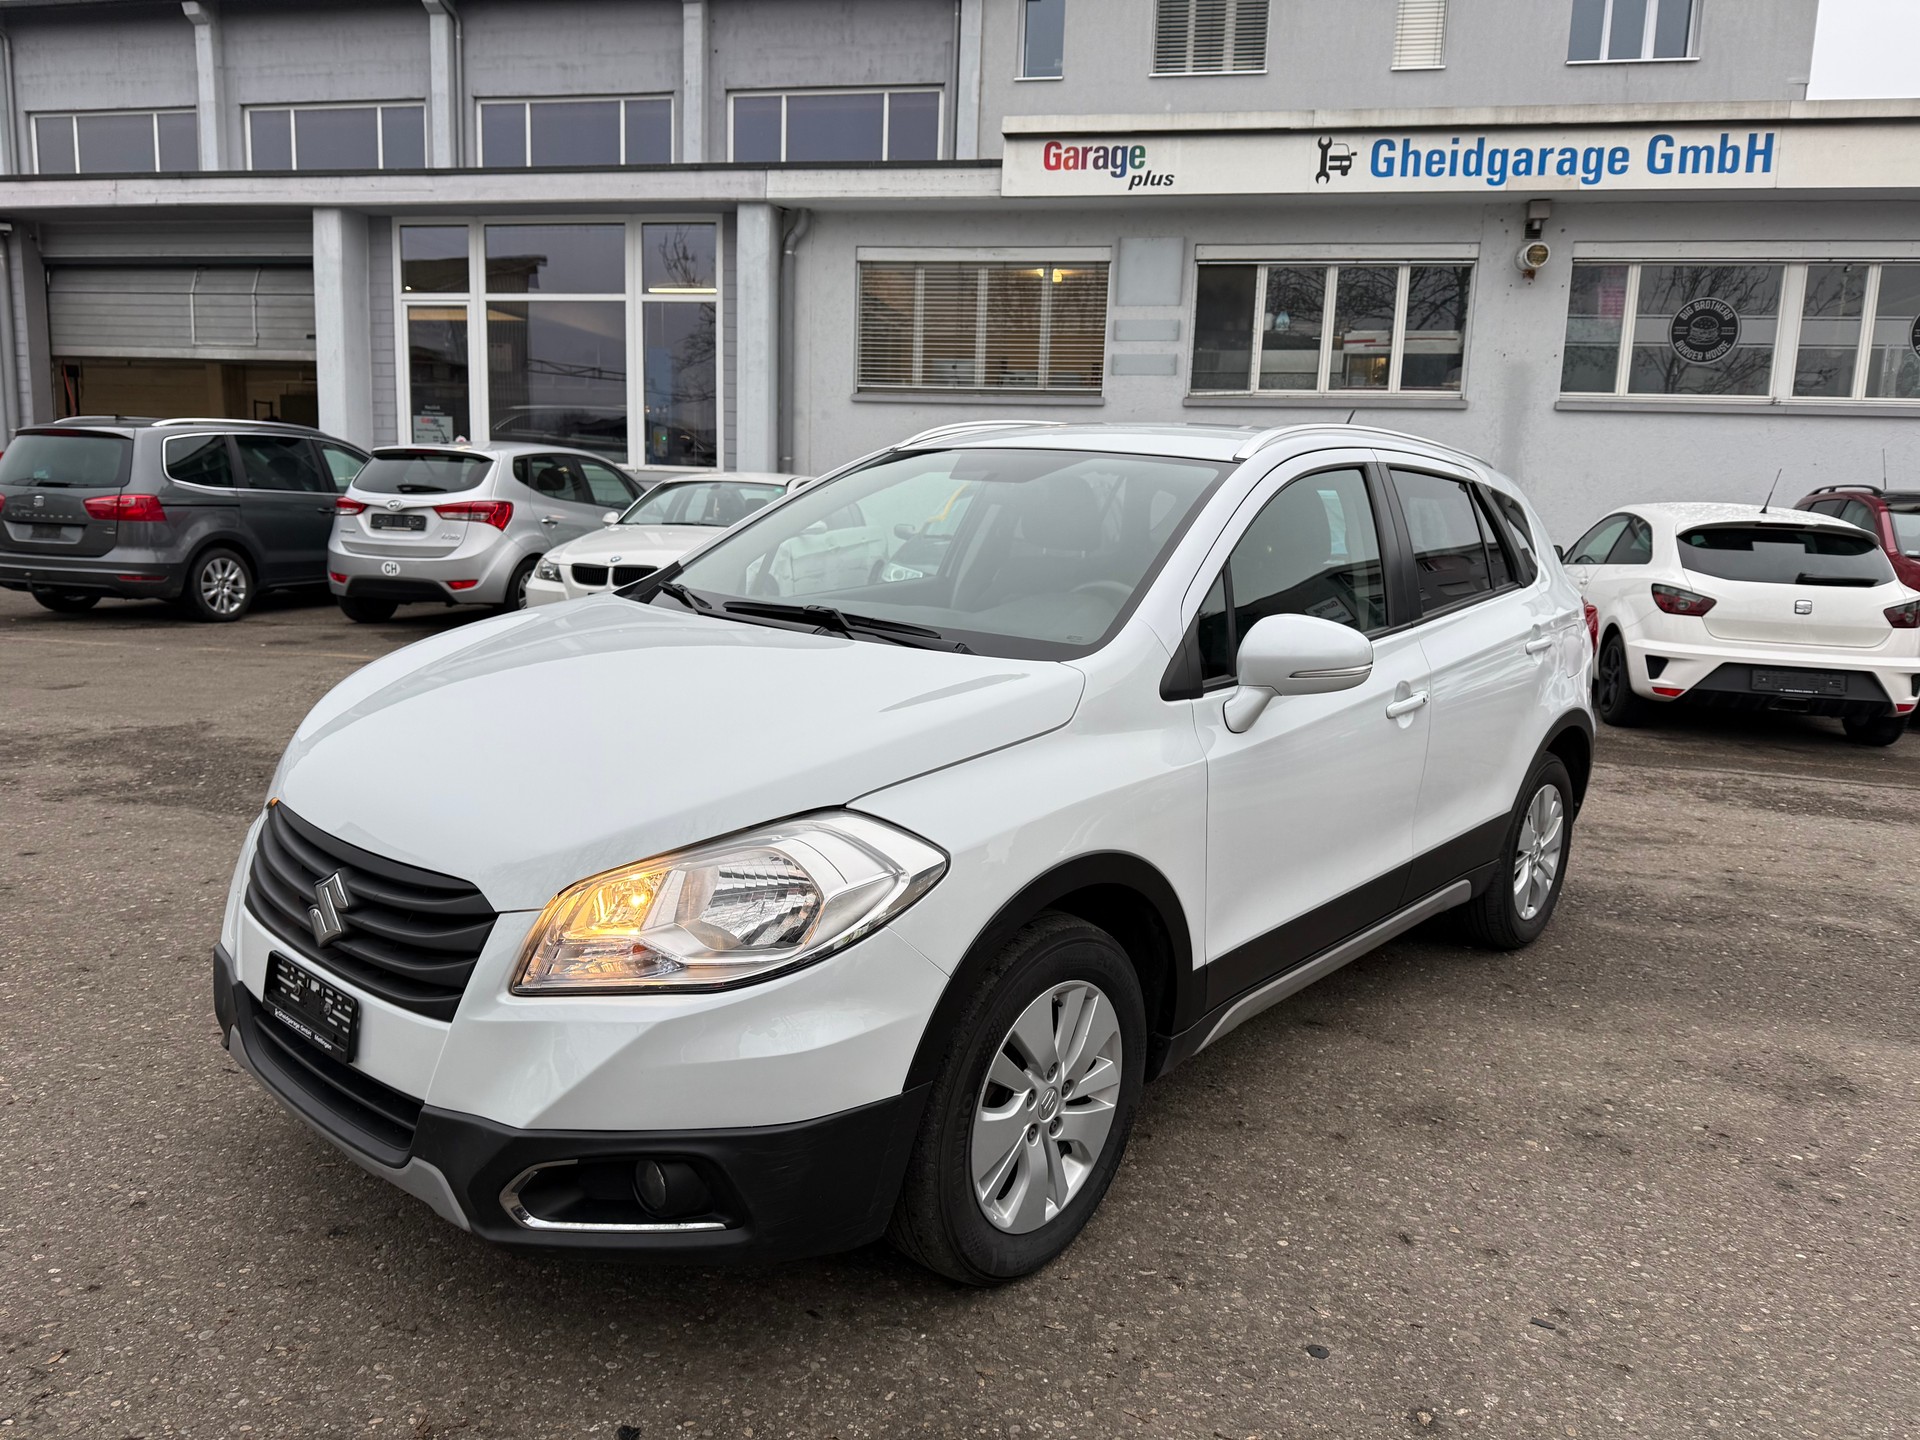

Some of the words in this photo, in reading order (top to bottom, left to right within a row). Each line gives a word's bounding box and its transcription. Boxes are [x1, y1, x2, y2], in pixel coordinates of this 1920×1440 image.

[1043, 141, 1146, 178] Garage
[1370, 138, 1630, 187] Gheidgarage
[1647, 133, 1774, 175] GmbH
[1127, 170, 1175, 191] plus
[1680, 306, 1694, 320] BIG
[1693, 300, 1734, 320] BROTHERS
[1675, 340, 1704, 361] BURGER
[1705, 340, 1731, 360] HOUSE
[384, 563, 397, 574] CH
